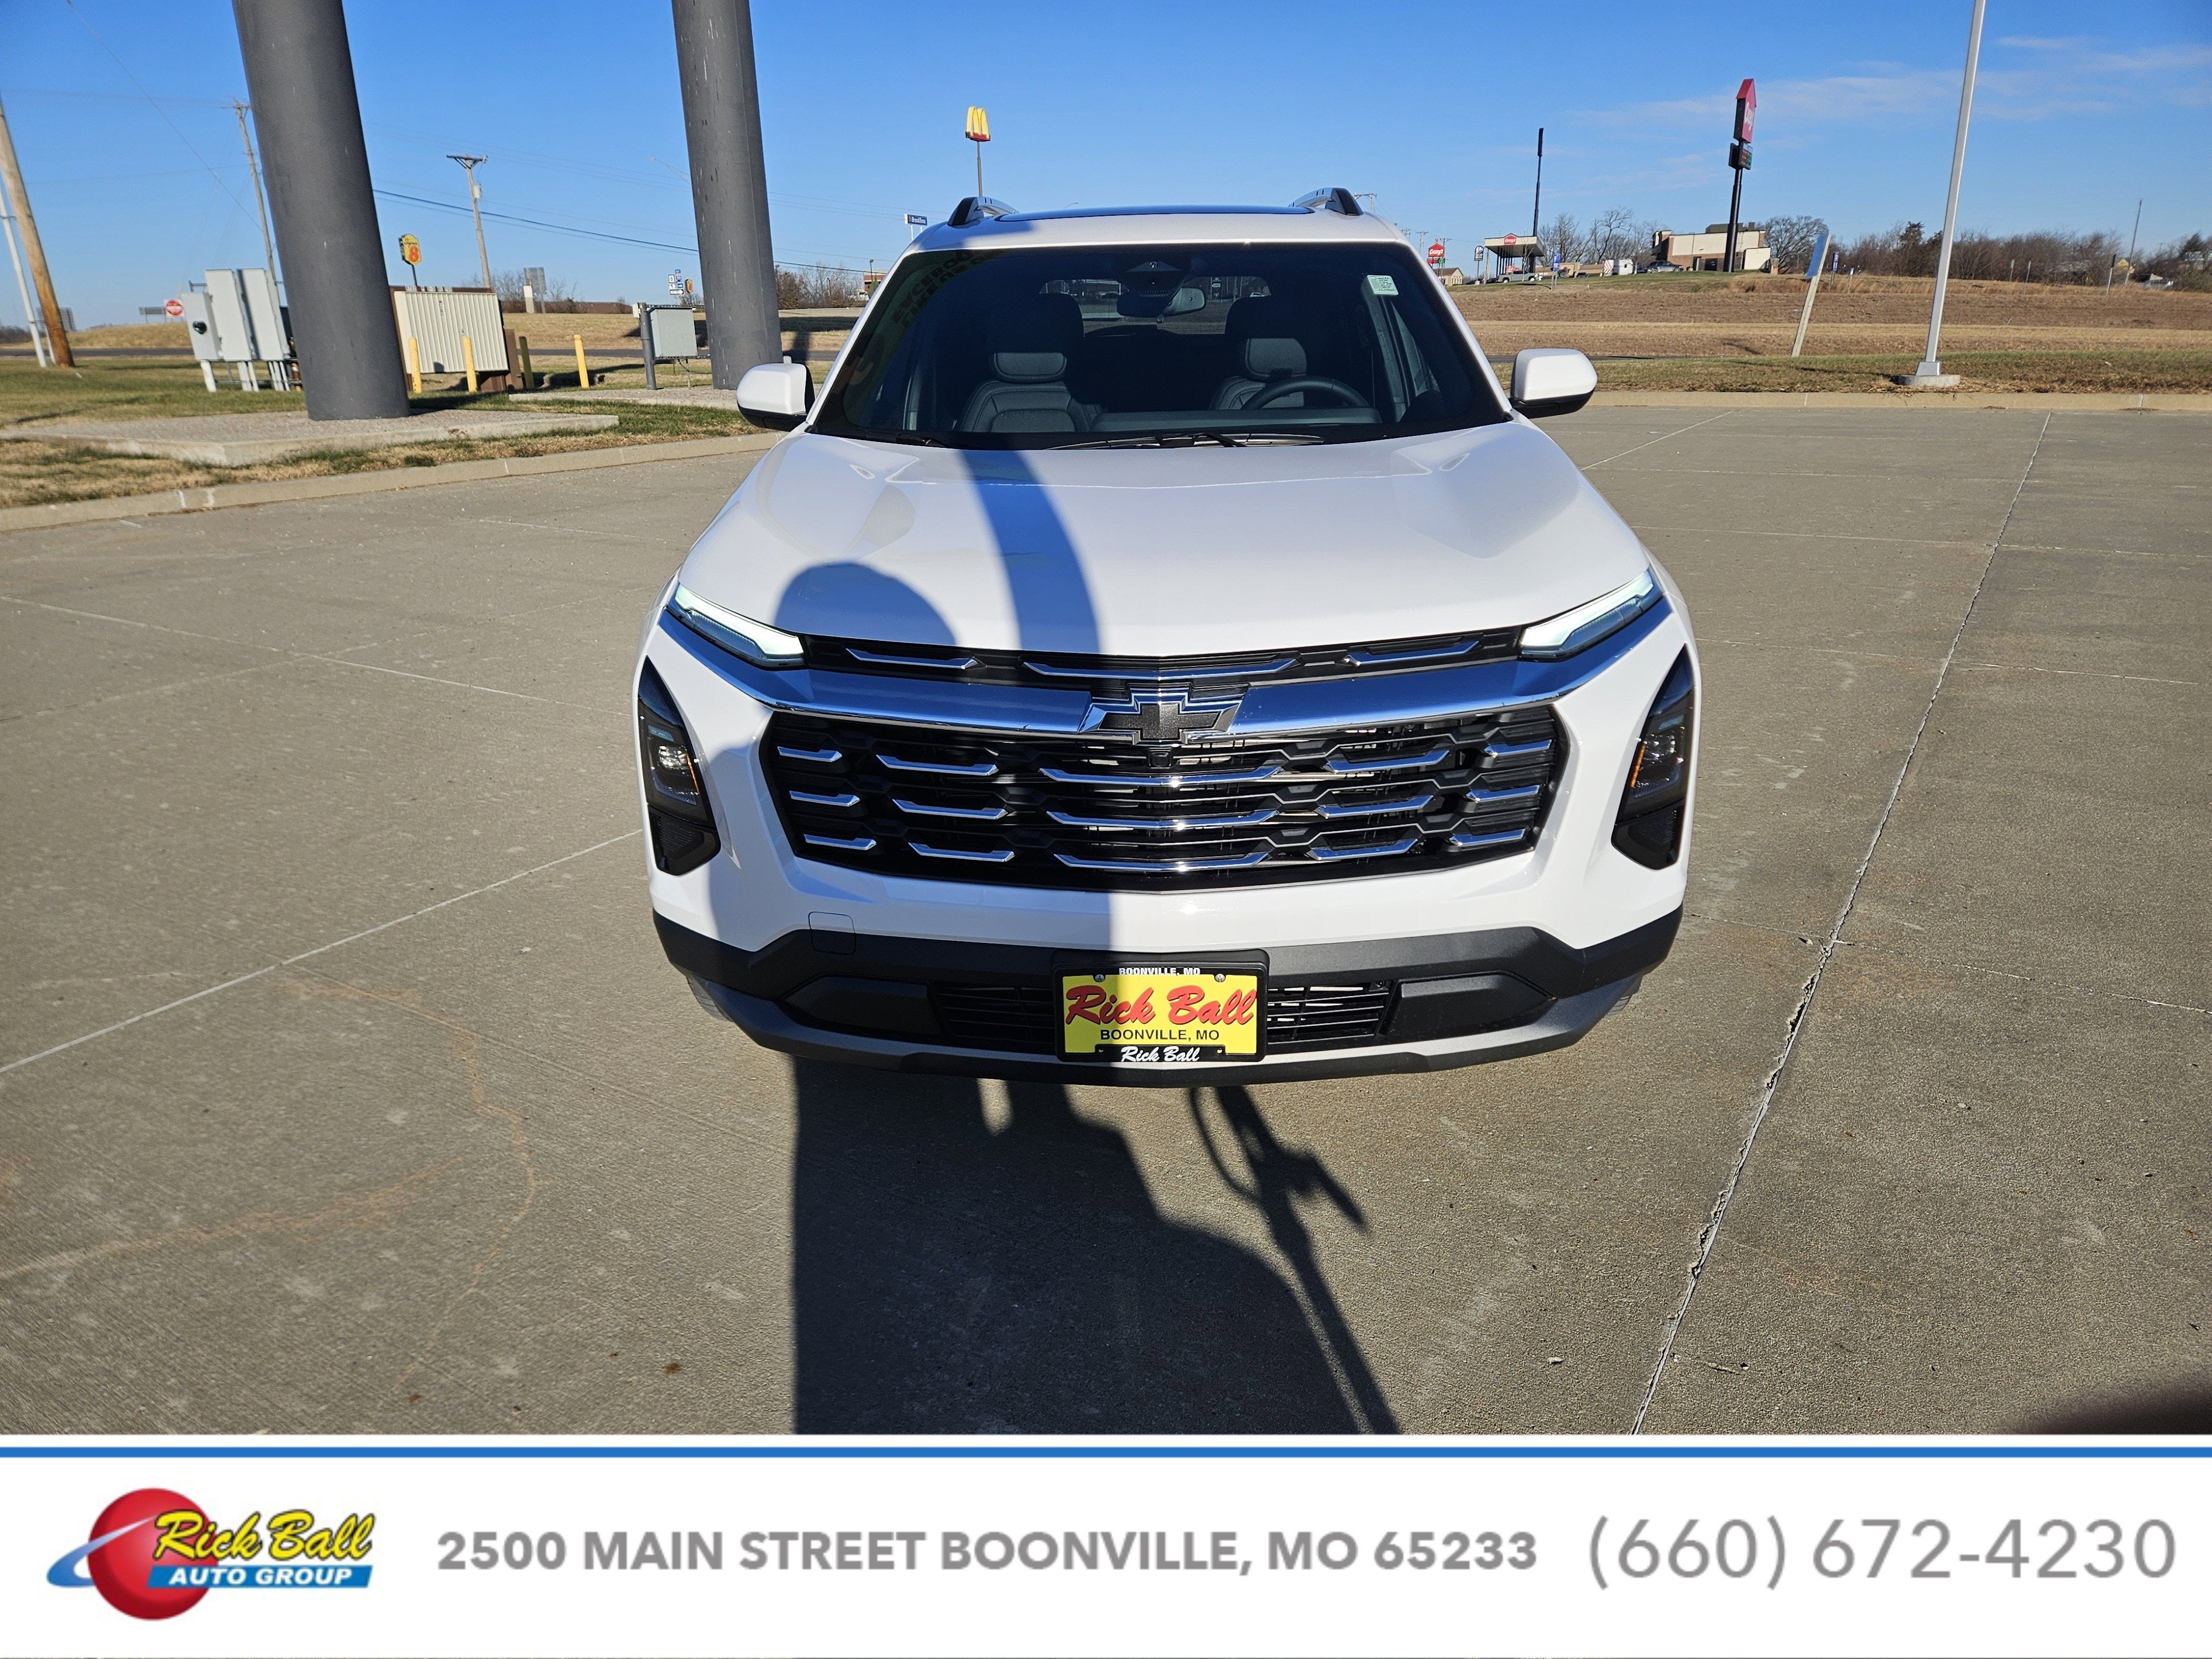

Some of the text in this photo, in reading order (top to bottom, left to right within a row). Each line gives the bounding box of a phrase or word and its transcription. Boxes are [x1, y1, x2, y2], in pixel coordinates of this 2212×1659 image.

[408, 245, 419, 262] 8
[1119, 967, 1201, 976] BOONVILLE, MO
[1065, 984, 1257, 1025] Rick Ball
[1100, 1029, 1220, 1042] BOONVILLE, MO
[1120, 1046, 1201, 1062] Rick Ball
